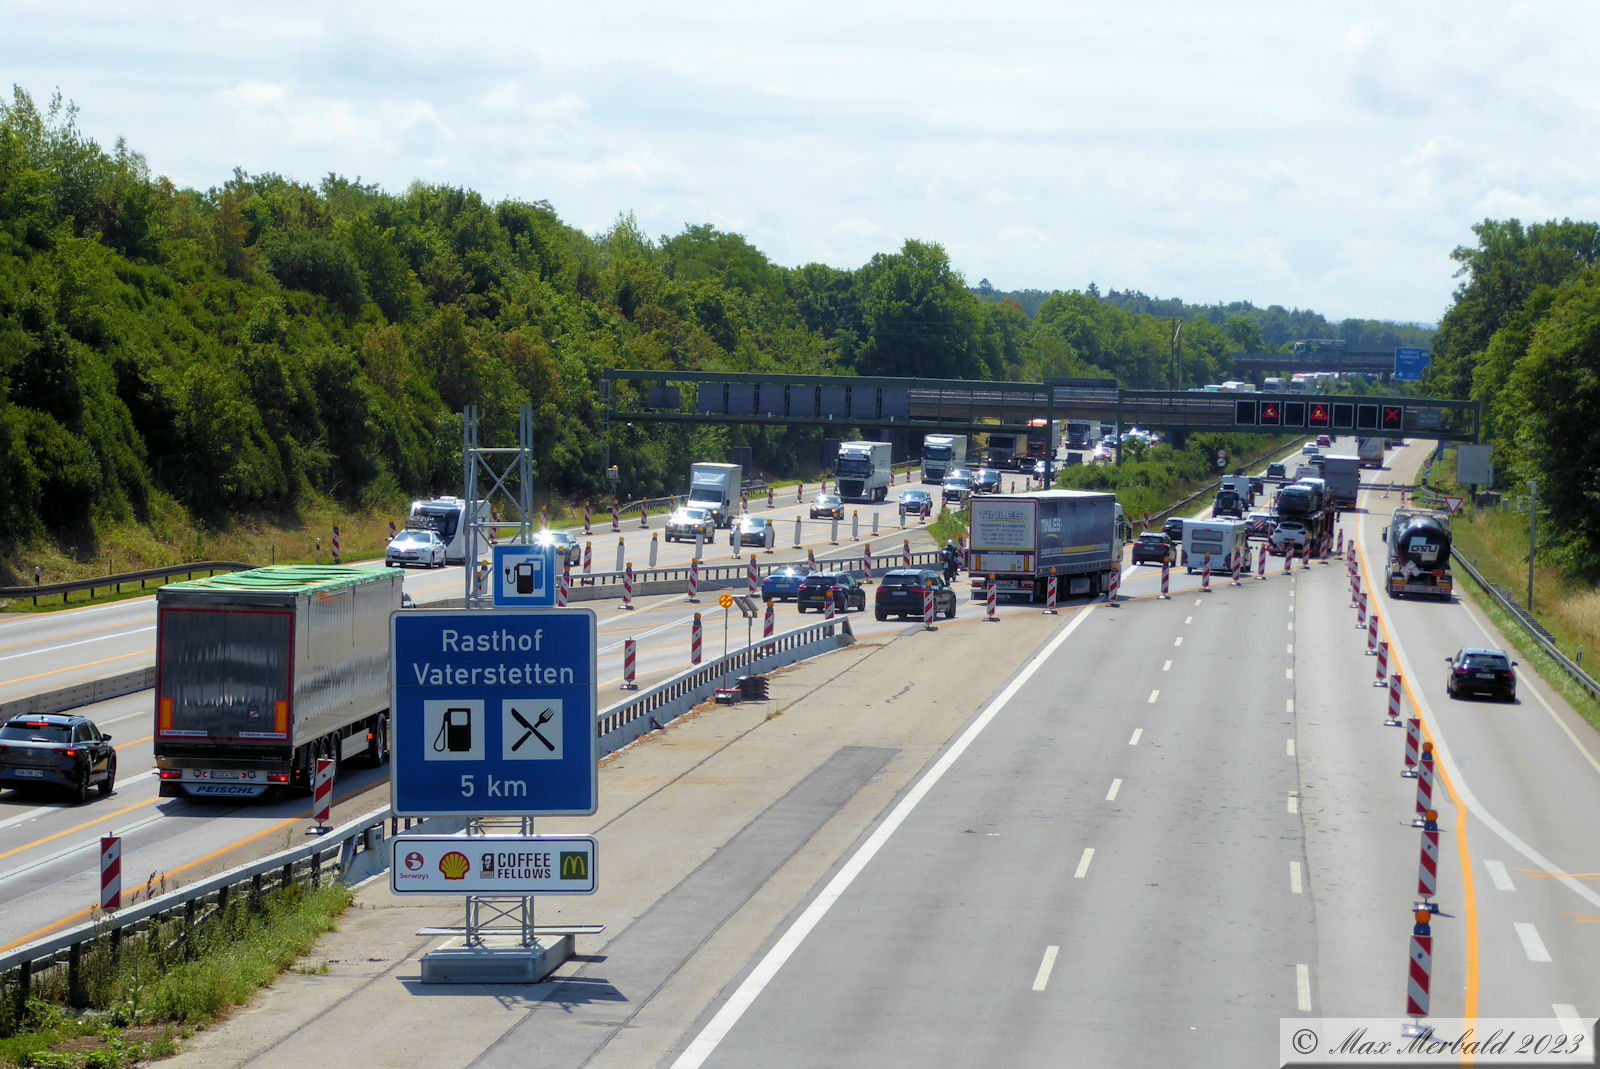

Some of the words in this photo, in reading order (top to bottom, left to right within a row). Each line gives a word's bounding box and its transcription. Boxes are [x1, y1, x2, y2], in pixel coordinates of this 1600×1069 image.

[442, 629, 543, 652] Rasthof
[413, 663, 574, 685] Vaterstetten
[196, 786, 255, 795] PEISCHL
[461, 775, 474, 797] 5
[488, 775, 527, 797] km
[498, 853, 551, 868] COFFEE
[400, 872, 429, 880] Serways
[498, 868, 551, 879] FELLOWS
